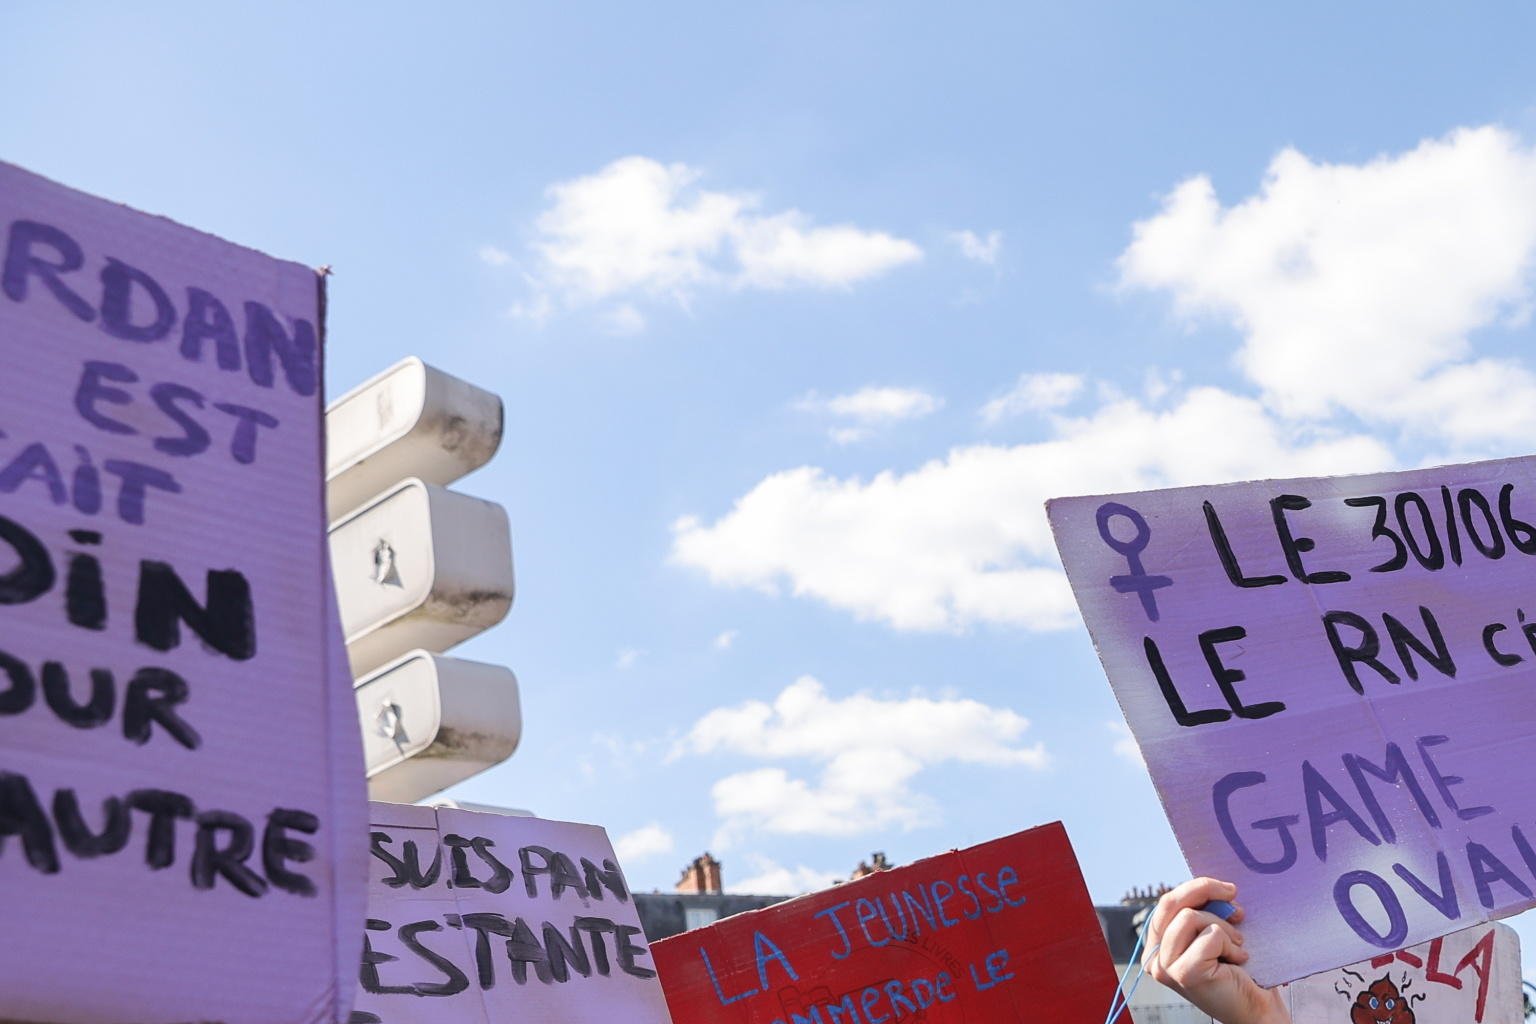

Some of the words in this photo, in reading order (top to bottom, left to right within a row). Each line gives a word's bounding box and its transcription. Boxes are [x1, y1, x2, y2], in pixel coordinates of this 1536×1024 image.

[73, 360, 280, 465] EST
[1203, 494, 1351, 587] LE
[1144, 626, 1286, 726] LE
[1322, 605, 1457, 695] RN
[0, 771, 319, 898] AUTRE
[1212, 735, 1494, 875] GAME
[369, 832, 514, 894] SUIS
[518, 845, 629, 904] PAN
[700, 930, 799, 1006] LA
